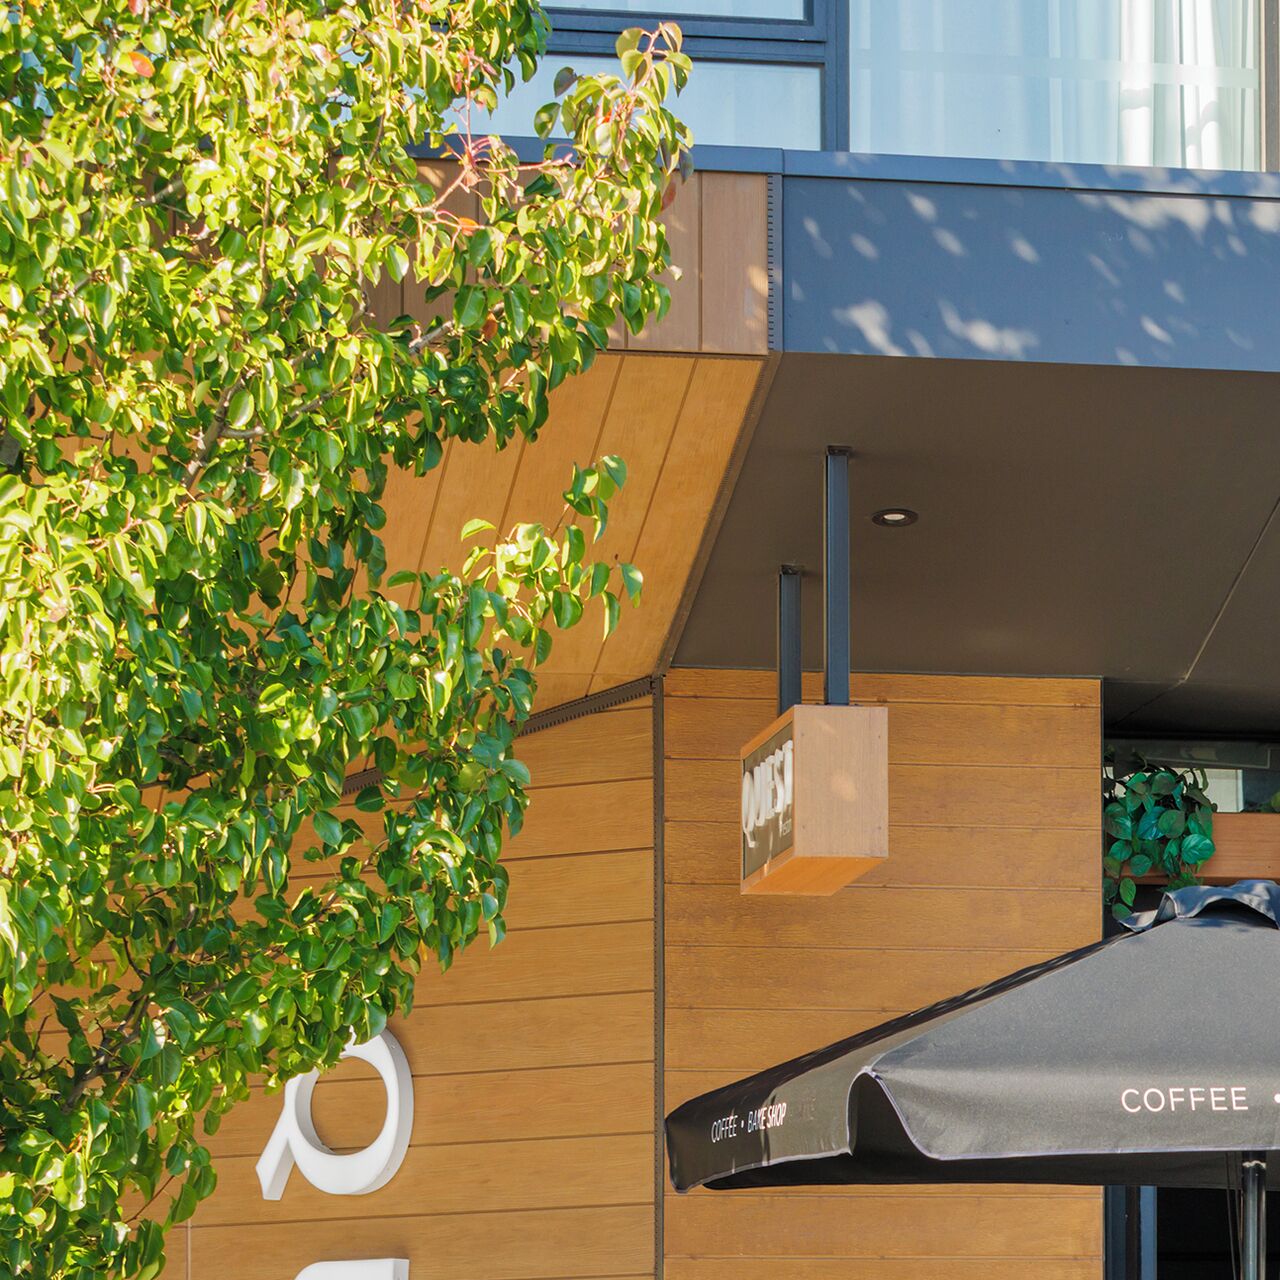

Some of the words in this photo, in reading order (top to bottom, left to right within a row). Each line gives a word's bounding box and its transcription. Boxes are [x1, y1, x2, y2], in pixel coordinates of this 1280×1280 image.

[1120, 1086, 1249, 1113] COFFEE
[711, 1114, 739, 1143] COFFEE
[748, 1107, 767, 1133] BAKE
[767, 1102, 787, 1128] SHOP
